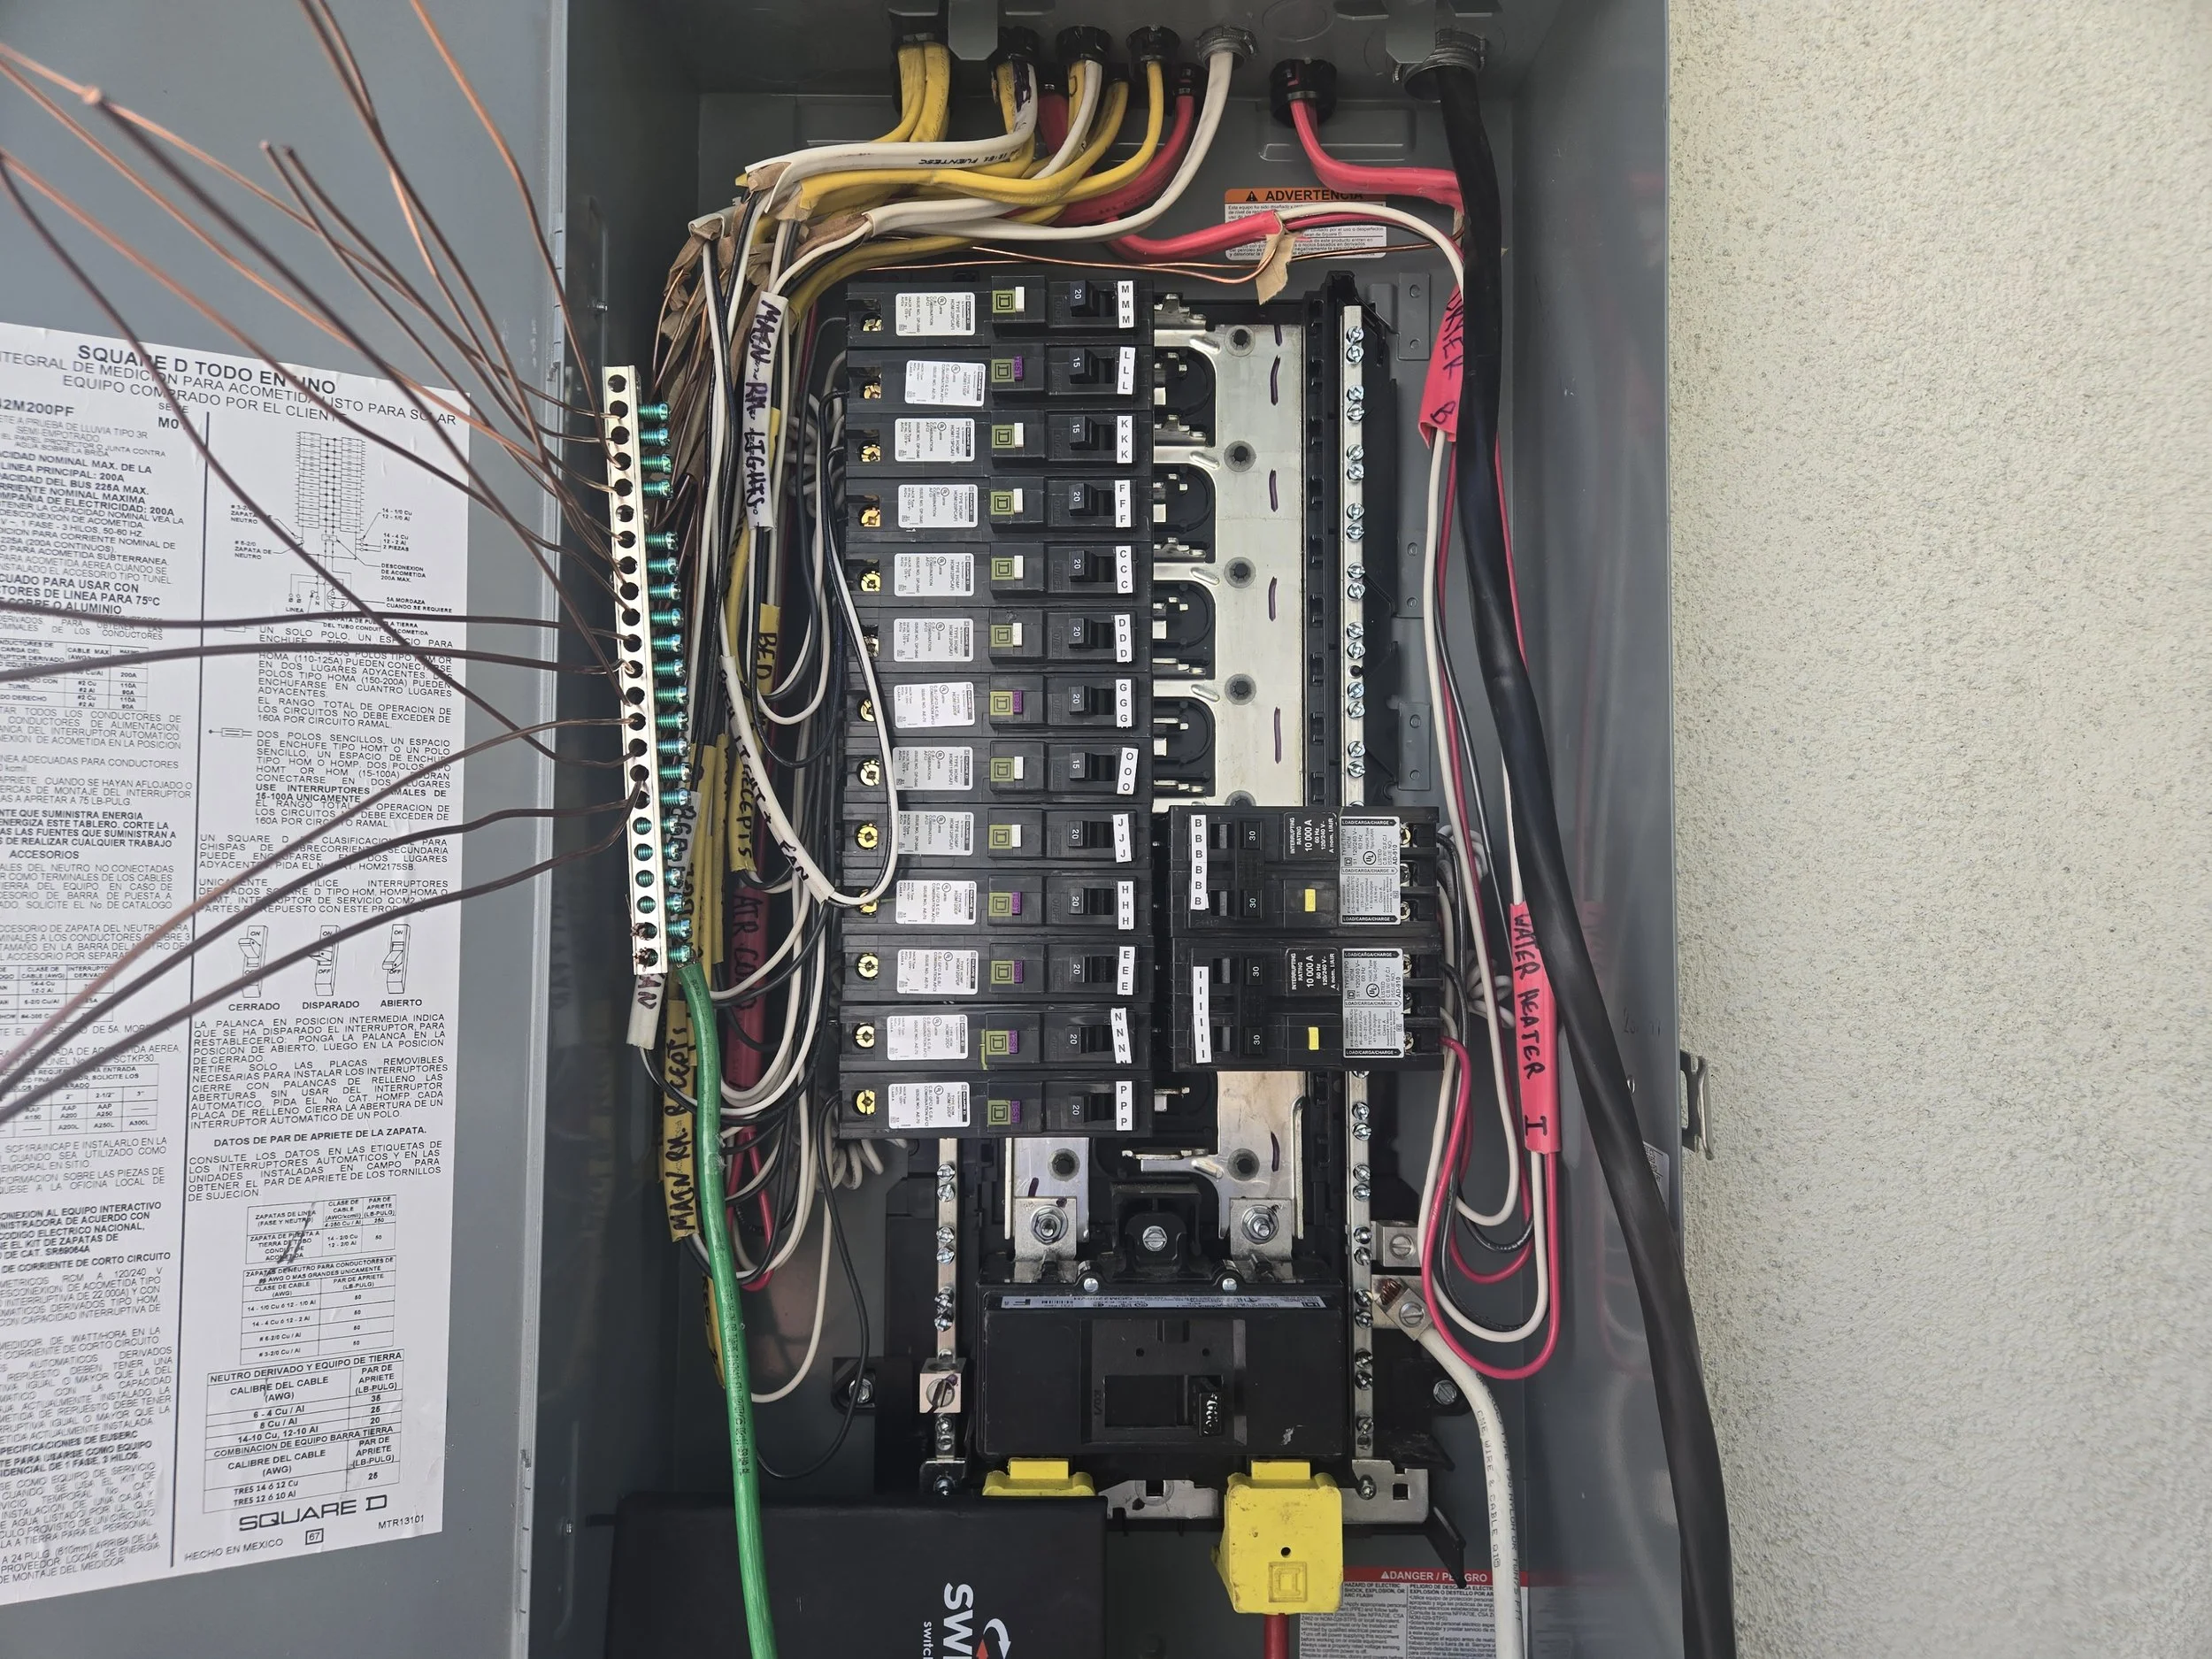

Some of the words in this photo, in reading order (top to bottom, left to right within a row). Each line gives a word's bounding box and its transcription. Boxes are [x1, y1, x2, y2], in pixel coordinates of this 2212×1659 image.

[1074, 288, 1081, 300] 20
[1073, 357, 1079, 367] 15
[175, 357, 188, 373] D
[195, 361, 252, 382] TODO
[260, 371, 286, 387] EN
[293, 375, 335, 394] NO
[64, 374, 125, 394] EQUIPO
[227, 396, 258, 411] POR
[264, 402, 280, 414] EL
[73, 361, 94, 373] DE
[183, 376, 224, 391] PARA
[368, 403, 406, 418] PARA
[411, 410, 456, 425] SOAR
[1430, 401, 1455, 425] B
[1073, 424, 1079, 434] 15
[1, 462, 33, 472] LINEA
[36, 465, 96, 480] PRINCIPAL:
[99, 473, 125, 482] 200A
[1073, 491, 1080, 502] 20
[1074, 558, 1081, 570] 20
[44, 588, 60, 599] DE
[64, 590, 96, 602] LINEA
[100, 594, 133, 604] PARA
[1073, 626, 1080, 637] 20
[1072, 694, 1079, 704] 20
[288, 732, 321, 741] POLOS
[409, 738, 450, 747] ESPACIO
[1073, 759, 1079, 769] 15
[288, 785, 371, 795] INTERRUPTORES
[1072, 829, 1079, 840] 20
[1250, 831, 1256, 841] 30
[1305, 842, 1312, 851] 10
[9, 850, 80, 859] ACCESORIOS
[1072, 896, 1079, 907] 20
[1250, 898, 1256, 908] 30
[1073, 964, 1080, 975] 20
[1253, 966, 1259, 976] 30
[735, 948, 758, 1010] COD
[228, 1002, 280, 1011] CERRADO
[303, 1001, 359, 1010] DISPARADO
[296, 1017, 344, 1026] POSICION
[349, 1015, 408, 1024] INTERMEDIA
[1071, 1033, 1077, 1045] 20
[1518, 989, 1545, 1079] HEATER
[1254, 1035, 1260, 1045] 30
[1072, 1104, 1079, 1116] 20
[213, 1137, 250, 1147] DATOS
[253, 1136, 267, 1145] DE
[270, 1134, 291, 1143] PAR
[294, 1133, 308, 1142] DE
[310, 1131, 353, 1141] APRIETE
[356, 1129, 369, 1138] DE
[371, 1128, 384, 1137] LA
[386, 1126, 427, 1136] ZAPATA.
[127, 1252, 171, 1263] CIRCUITO
[210, 1371, 251, 1383] NEUTRO
[254, 1363, 303, 1379] DERIVADO
[315, 1359, 351, 1371] EQUIPO
[369, 1352, 402, 1363] TIERRA
[230, 1384, 273, 1395] CALIBRE
[275, 1381, 294, 1390] DEL
[296, 1376, 329, 1386] CABLE
[265, 1391, 295, 1402] (AWG)
[239, 1499, 357, 1532] SQUARE
[365, 1494, 388, 1511] D
[378, 1515, 425, 1530] MTR13101
[184, 1548, 223, 1562] HECHO
[226, 1545, 241, 1555] EN
[243, 1538, 283, 1552] MEXICO
[1390, 1571, 1432, 1580] DANGER
[1442, 1573, 1487, 1582] PEGRO
[943, 1582, 973, 1659] SW
